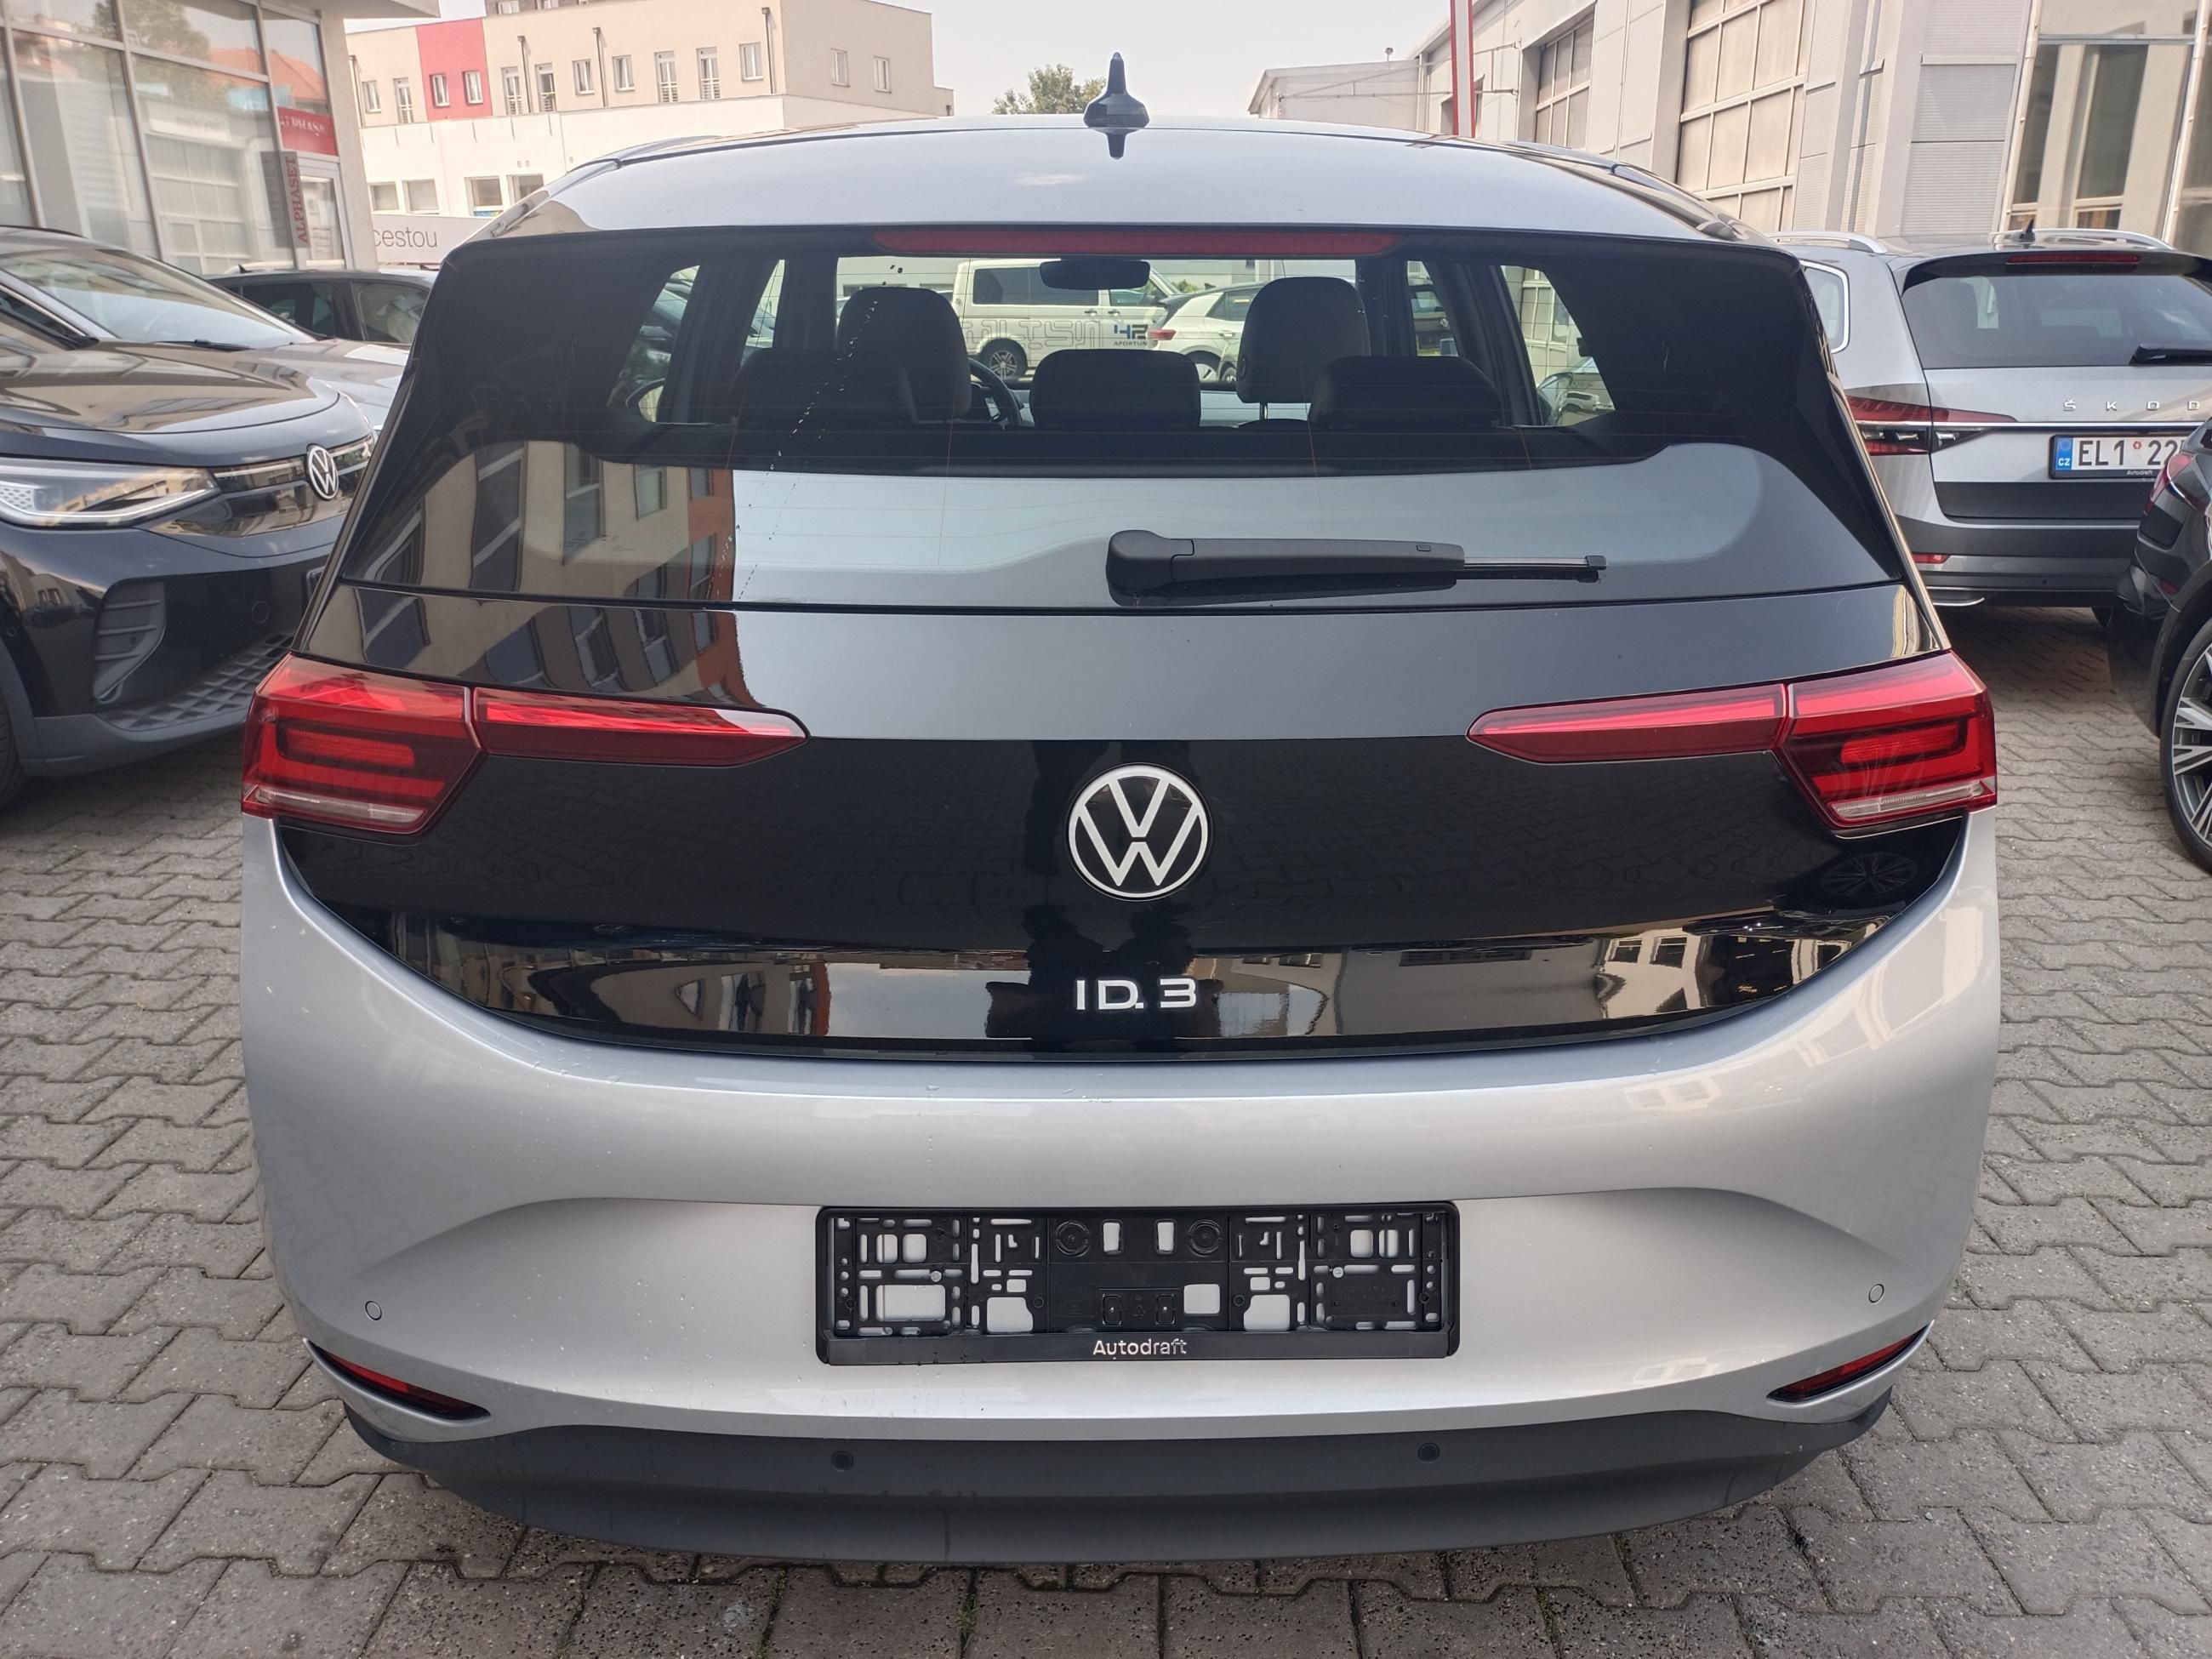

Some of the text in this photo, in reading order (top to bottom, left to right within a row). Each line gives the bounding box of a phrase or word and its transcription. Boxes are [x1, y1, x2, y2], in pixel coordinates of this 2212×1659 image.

[286, 157, 308, 243] ALPHASET
[373, 227, 437, 248] cestou
[2058, 458, 2071, 466] CZ
[2147, 440, 2185, 466] 22
[1092, 1338, 1188, 1355] Autodraft
